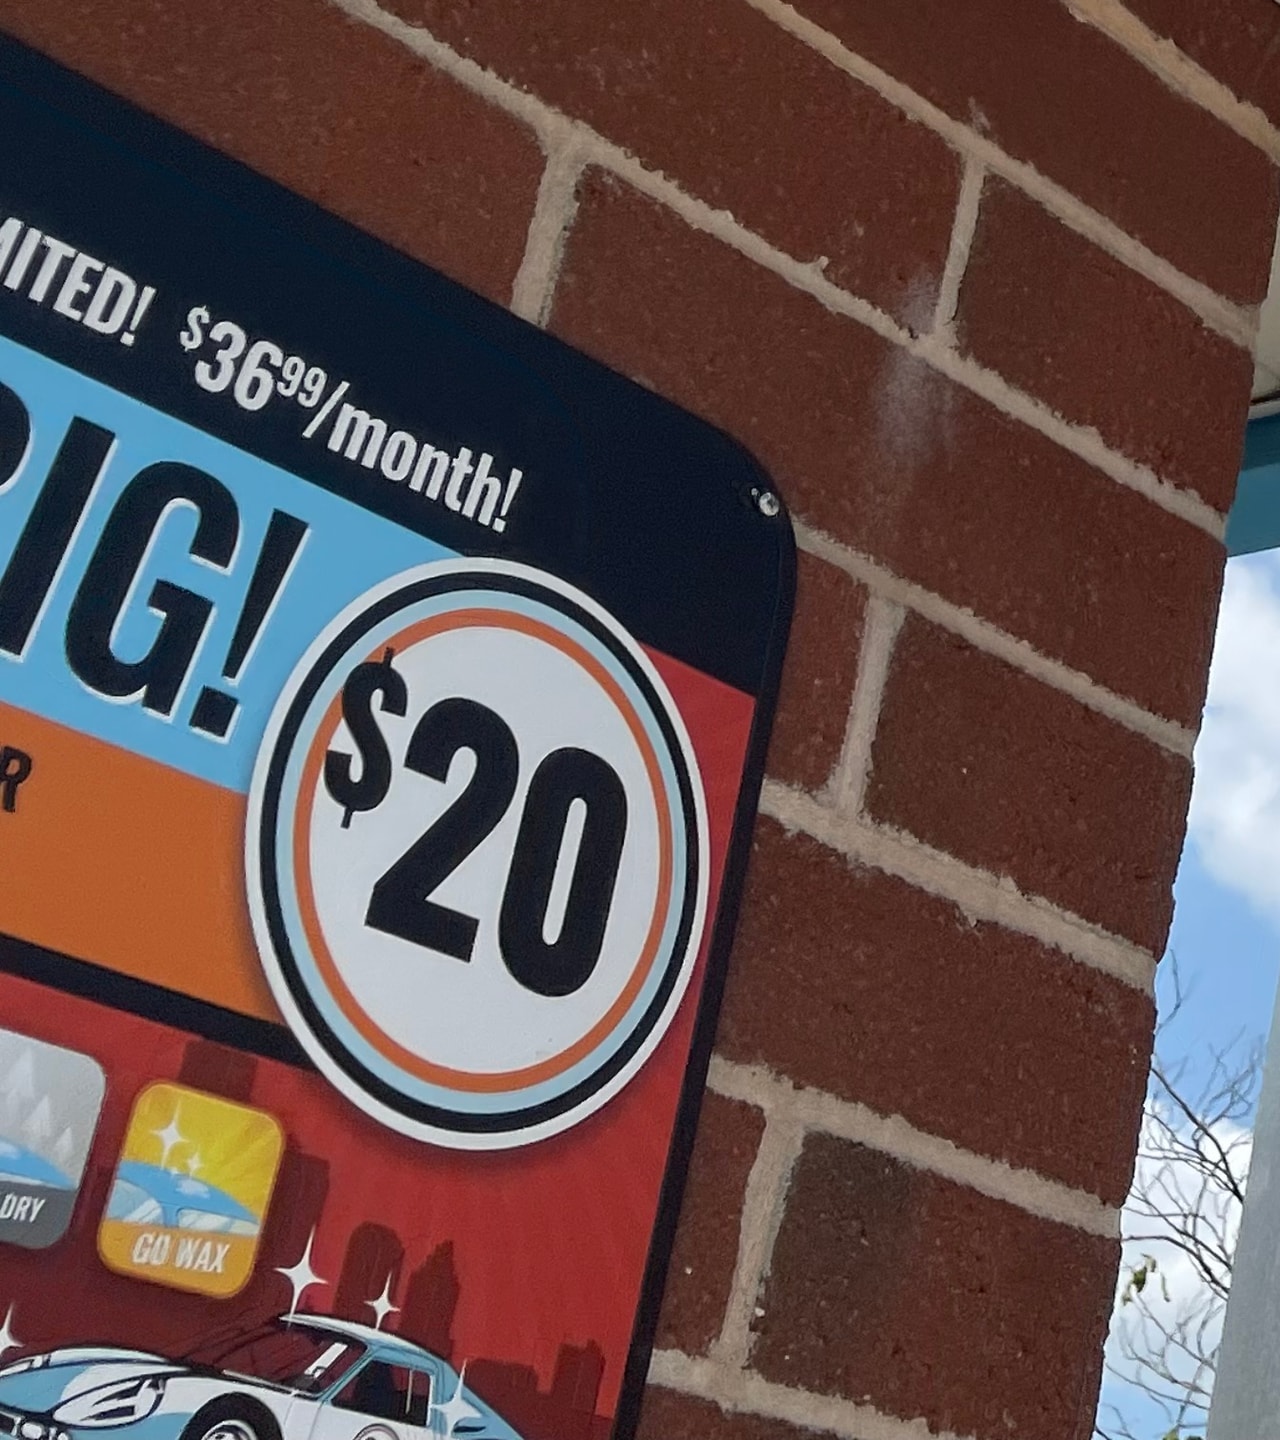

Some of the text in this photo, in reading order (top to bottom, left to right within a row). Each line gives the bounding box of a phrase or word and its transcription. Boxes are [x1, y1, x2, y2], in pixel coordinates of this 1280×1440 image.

[0, 380, 312, 744] IG!
[324, 647, 628, 998] $20
[132, 1231, 229, 1274] GO WAX
